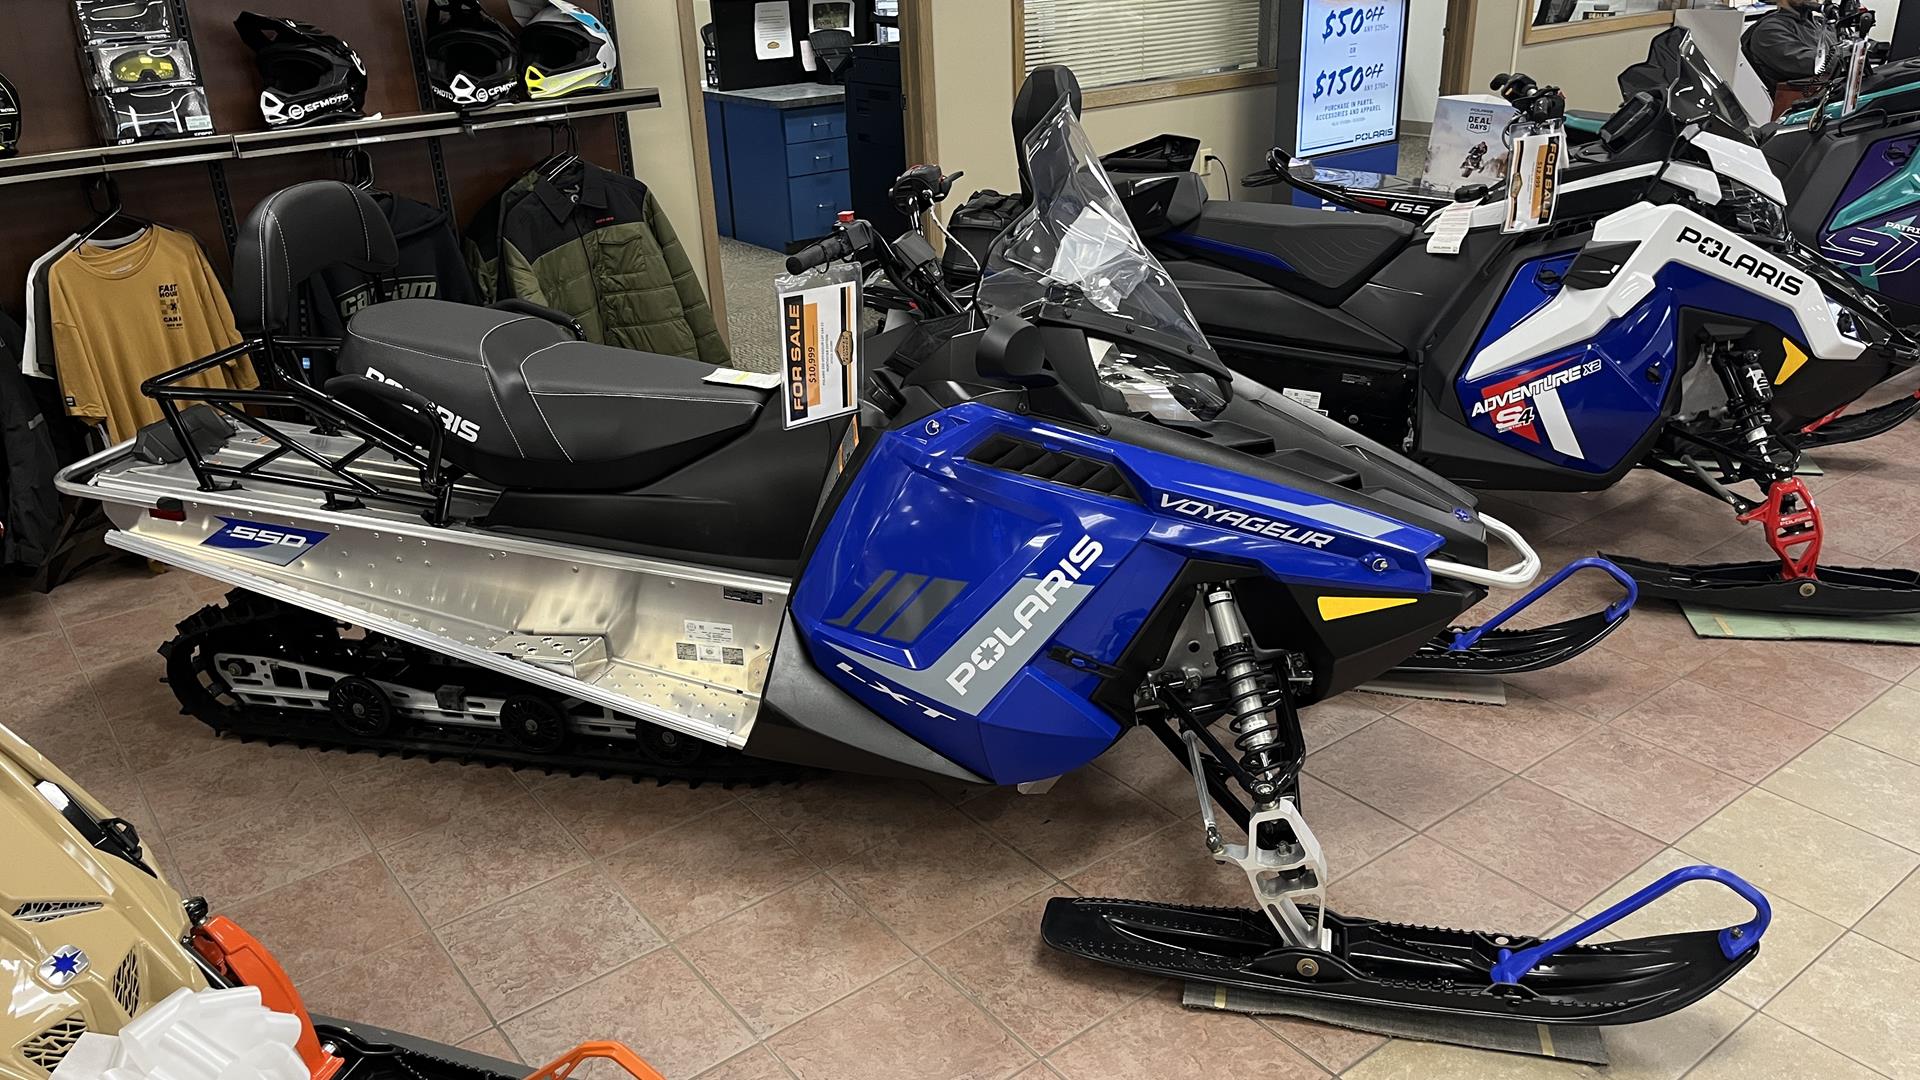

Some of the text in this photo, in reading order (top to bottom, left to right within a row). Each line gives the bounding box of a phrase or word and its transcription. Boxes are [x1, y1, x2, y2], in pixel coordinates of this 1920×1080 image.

[1322, 7, 1364, 44] $50
[1313, 65, 1364, 104] $150
[1316, 110, 1348, 121] ACCESSORIES
[1360, 104, 1381, 114] APPAREL
[1324, 102, 1349, 112] PURCHASE
[1468, 116, 1491, 124] DEAL
[1354, 128, 1393, 142] POLARIS
[1541, 143, 1557, 219] FOR SALE
[1390, 202, 1430, 216] 155
[1676, 225, 1804, 297] POLARIS
[159, 284, 177, 293] FAST
[789, 304, 805, 411] FOR SALE
[808, 346, 817, 384] $10,999
[1471, 358, 1602, 418] ADVENTURE X2
[229, 525, 307, 548] 550
[1159, 491, 1336, 549] VOYAGEUR
[945, 533, 1105, 697] POLARIS
[835, 661, 957, 722] LXT
